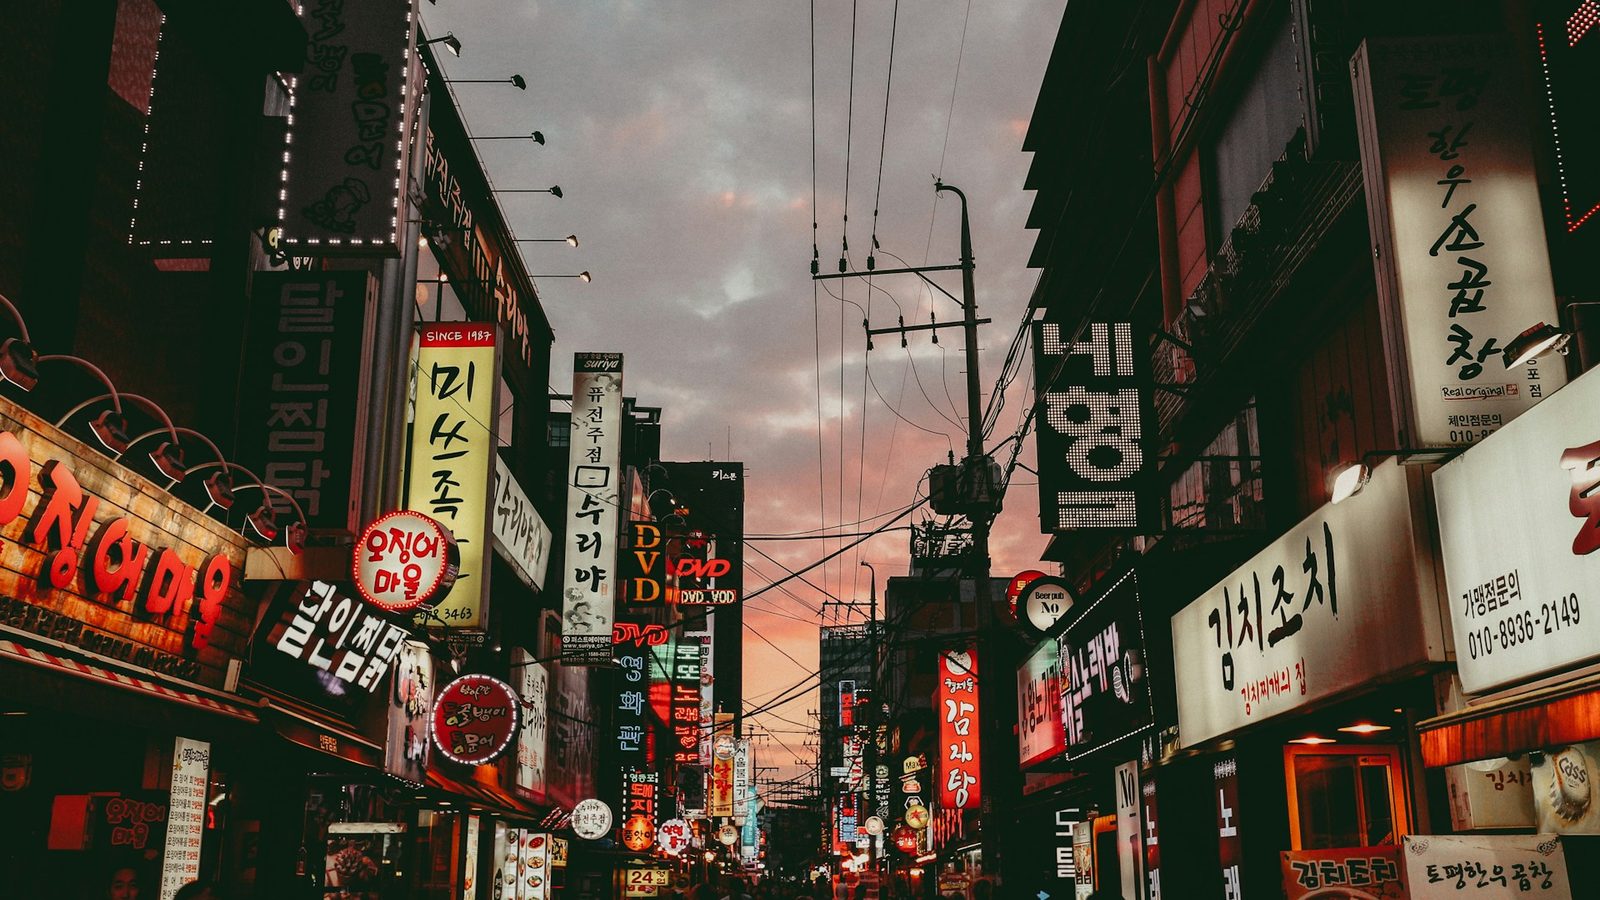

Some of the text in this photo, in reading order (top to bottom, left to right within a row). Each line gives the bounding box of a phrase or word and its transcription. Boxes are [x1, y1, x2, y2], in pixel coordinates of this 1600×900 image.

[427, 329, 492, 342] SINCE 1987
[583, 357, 620, 371] suriya
[261, 281, 344, 517] 달인찜닭
[1442, 386, 1463, 397] Real
[584, 386, 606, 463] 퓨전주점
[1448, 414, 1503, 427] 체인점문의
[430, 361, 473, 578] 미쓰족
[366, 528, 439, 564] 오징어
[574, 494, 607, 593] 수리야
[633, 524, 661, 602] DVD
[675, 558, 731, 577] DVD
[374, 563, 422, 600] 마을
[1035, 591, 1065, 600] Beer pub
[1462, 569, 1522, 619] 가맹점문의
[444, 607, 472, 621] 3463
[1041, 601, 1059, 614] No
[1208, 521, 1339, 692] 김치조치
[276, 580, 405, 693] 달인찜닭
[612, 622, 669, 648] DVD
[1468, 592, 1580, 660] 010-8936-2149
[1294, 656, 1307, 696] 집
[945, 699, 977, 808] 감자탕
[1557, 756, 1586, 784] Cass
[107, 798, 166, 824] 오징어
[111, 823, 149, 849] 마을
[631, 871, 653, 884] 24
[1291, 857, 1400, 889] 김치조치
